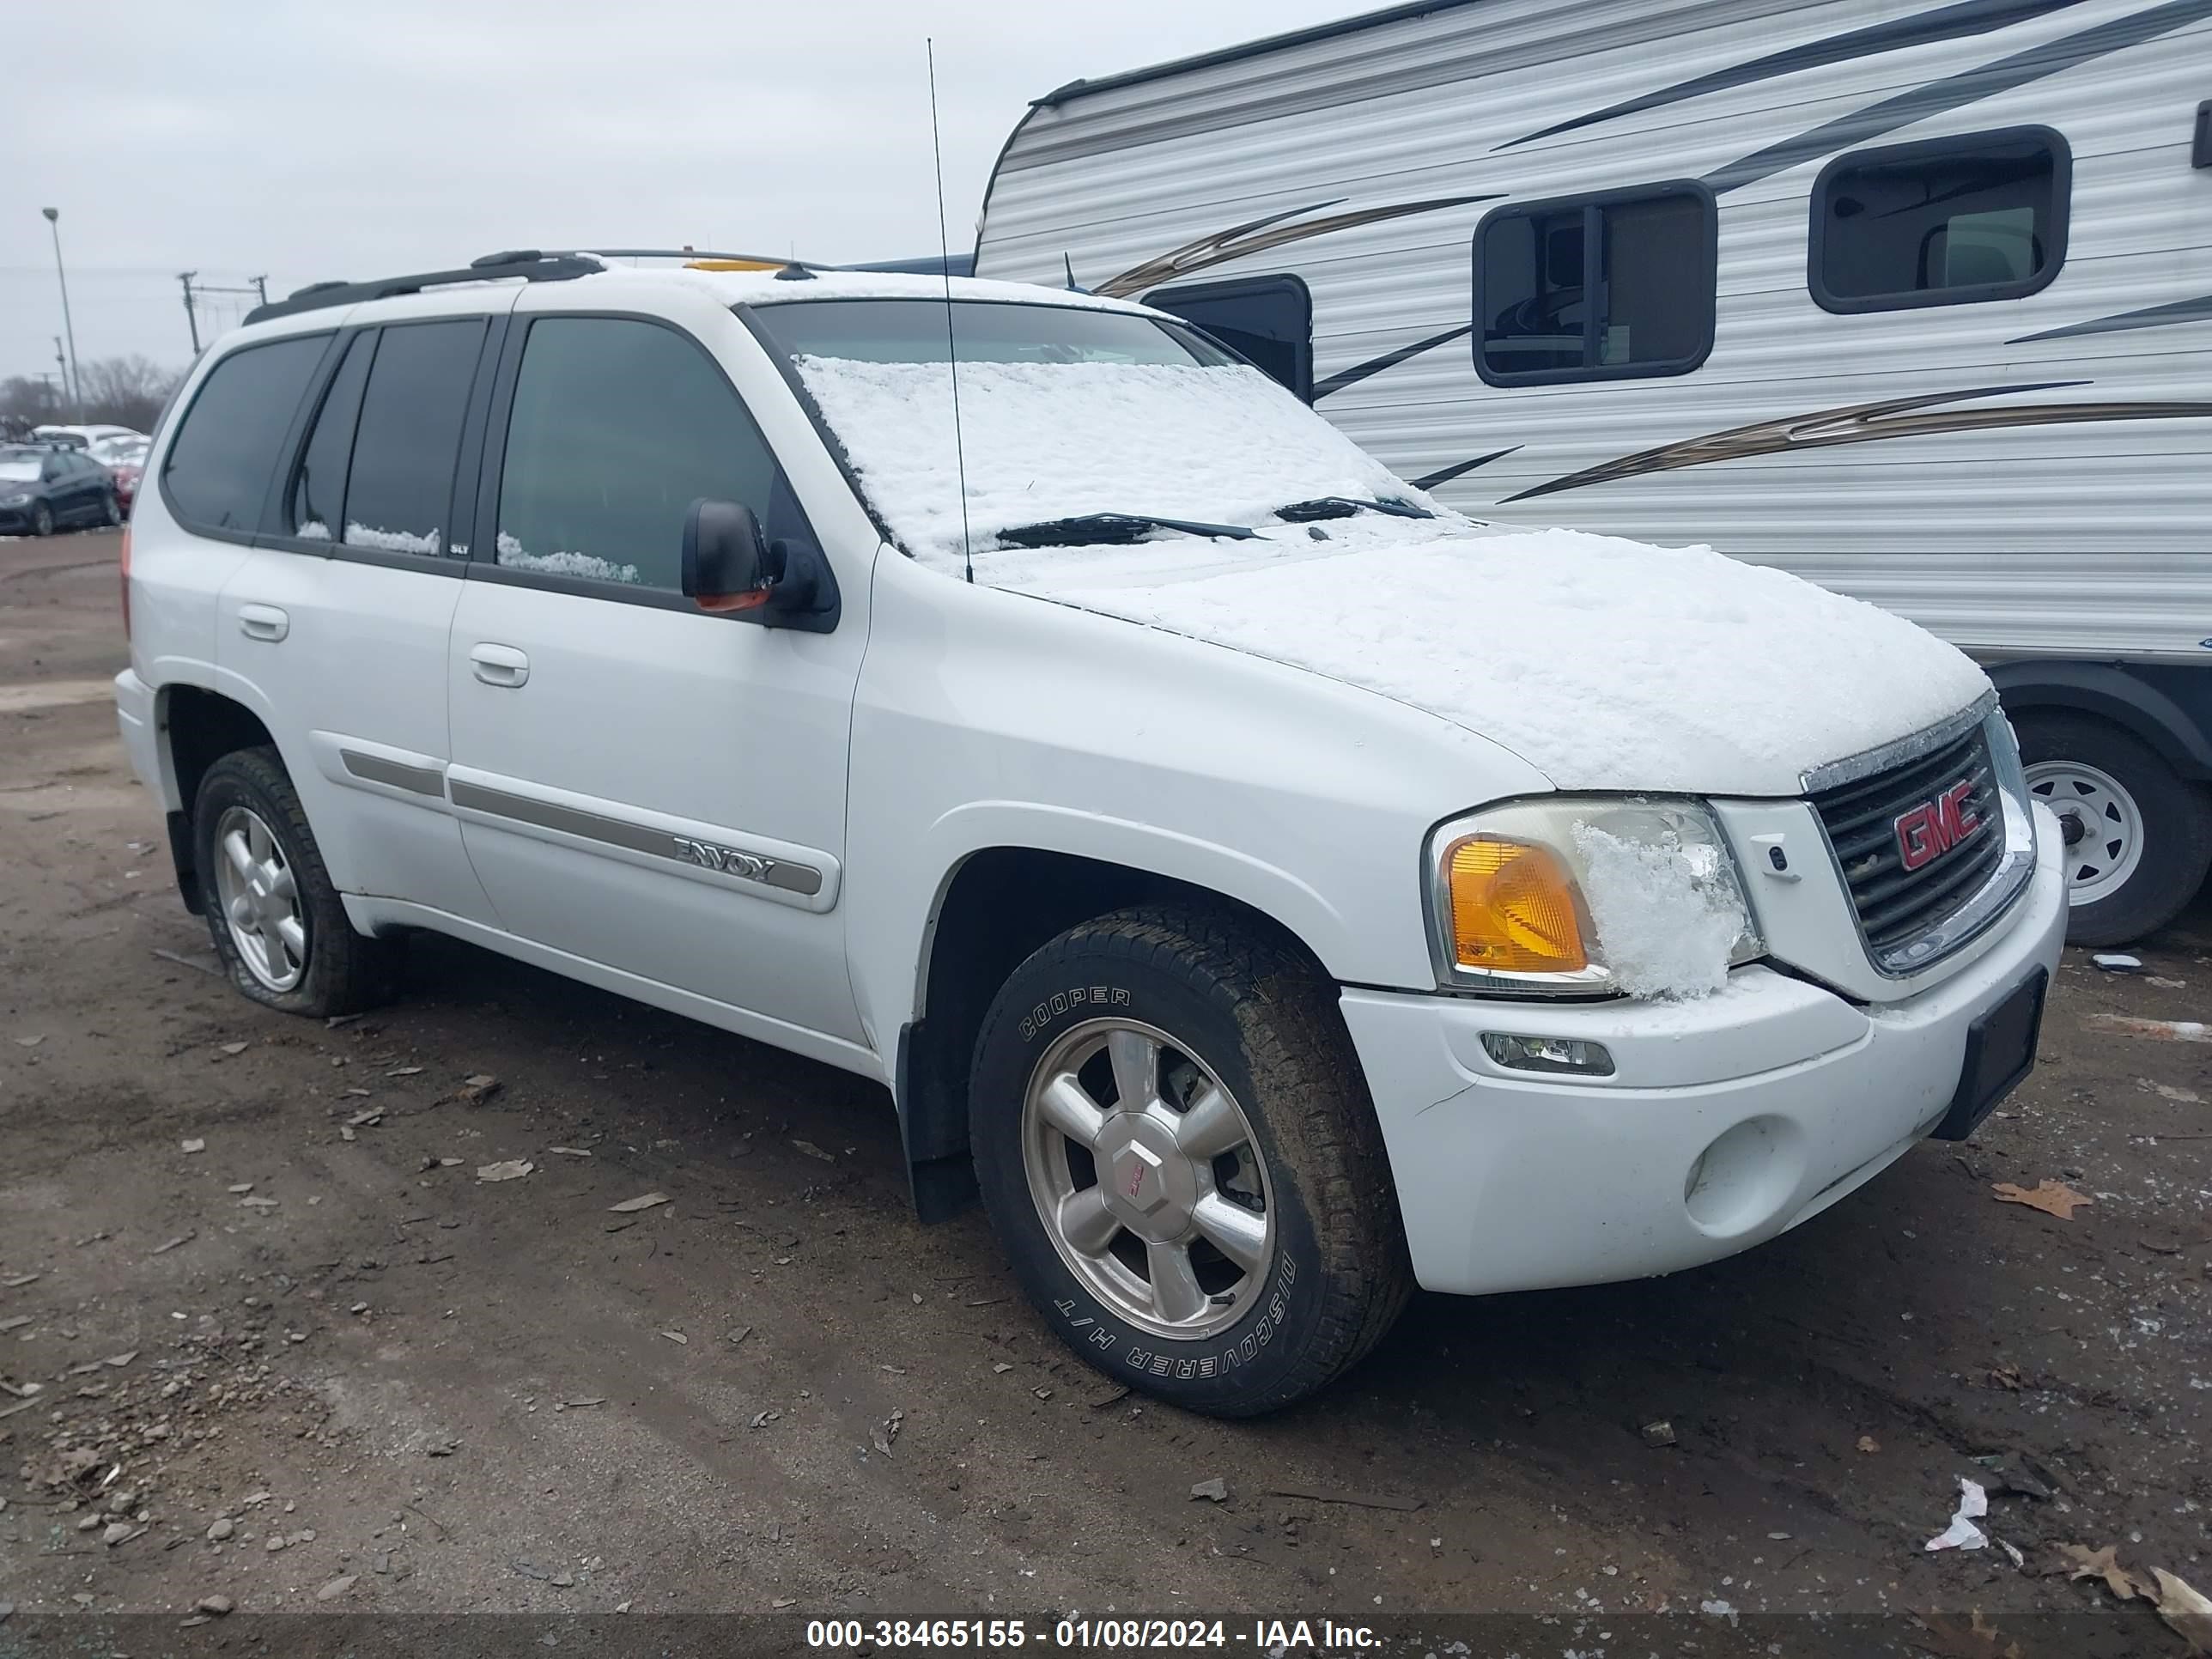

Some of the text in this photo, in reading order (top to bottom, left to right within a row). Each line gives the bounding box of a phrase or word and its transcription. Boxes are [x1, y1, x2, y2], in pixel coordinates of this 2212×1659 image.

[449, 544, 469, 555] SLT
[1893, 779, 1979, 872] GMC
[673, 837, 775, 881] ENVOY
[1018, 987, 1131, 1042] COOPER
[1054, 1250, 1297, 1379] DISCOVERER H/T
